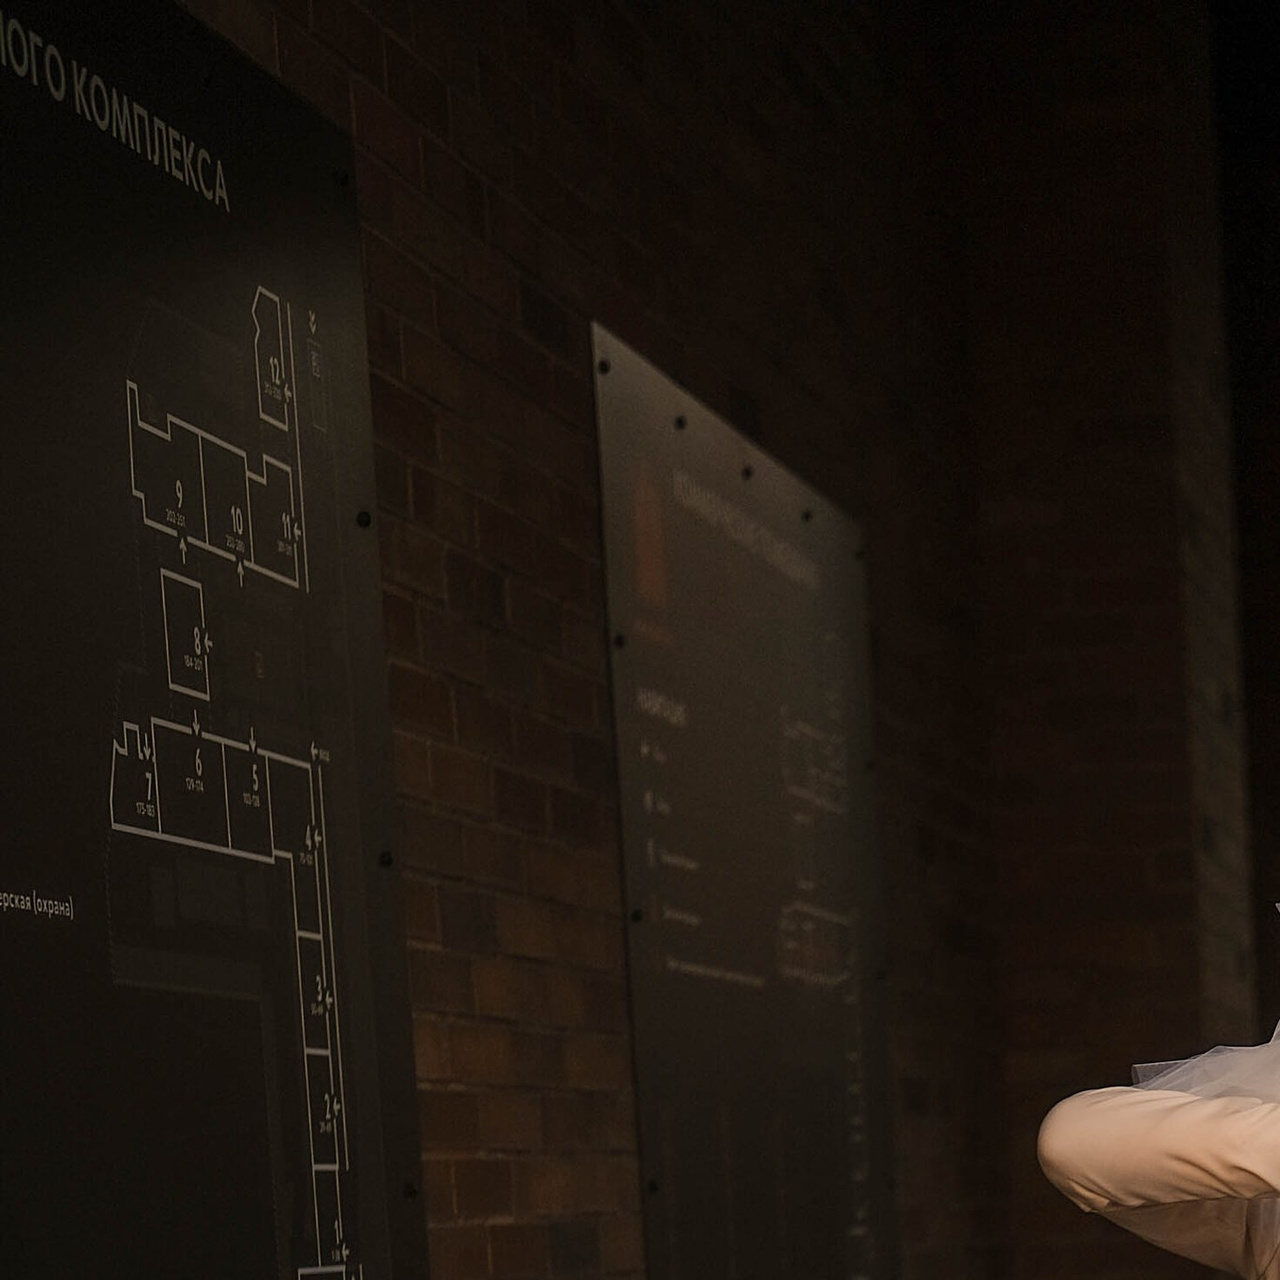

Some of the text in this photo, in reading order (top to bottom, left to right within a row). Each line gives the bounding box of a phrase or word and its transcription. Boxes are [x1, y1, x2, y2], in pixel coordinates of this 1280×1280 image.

[72, 60, 230, 213] КОМПЛЕКСА
[269, 356, 280, 385] 12
[176, 480, 183, 508] 9
[231, 505, 243, 535] 10
[282, 512, 291, 540] 11
[194, 627, 201, 655] 8
[195, 747, 203, 776] 6
[145, 771, 152, 801] 7
[252, 763, 259, 791] 5
[305, 824, 312, 851] 4
[33, 890, 74, 920] (охрана)
[316, 975, 323, 1002] 3
[324, 1093, 332, 1120] 2
